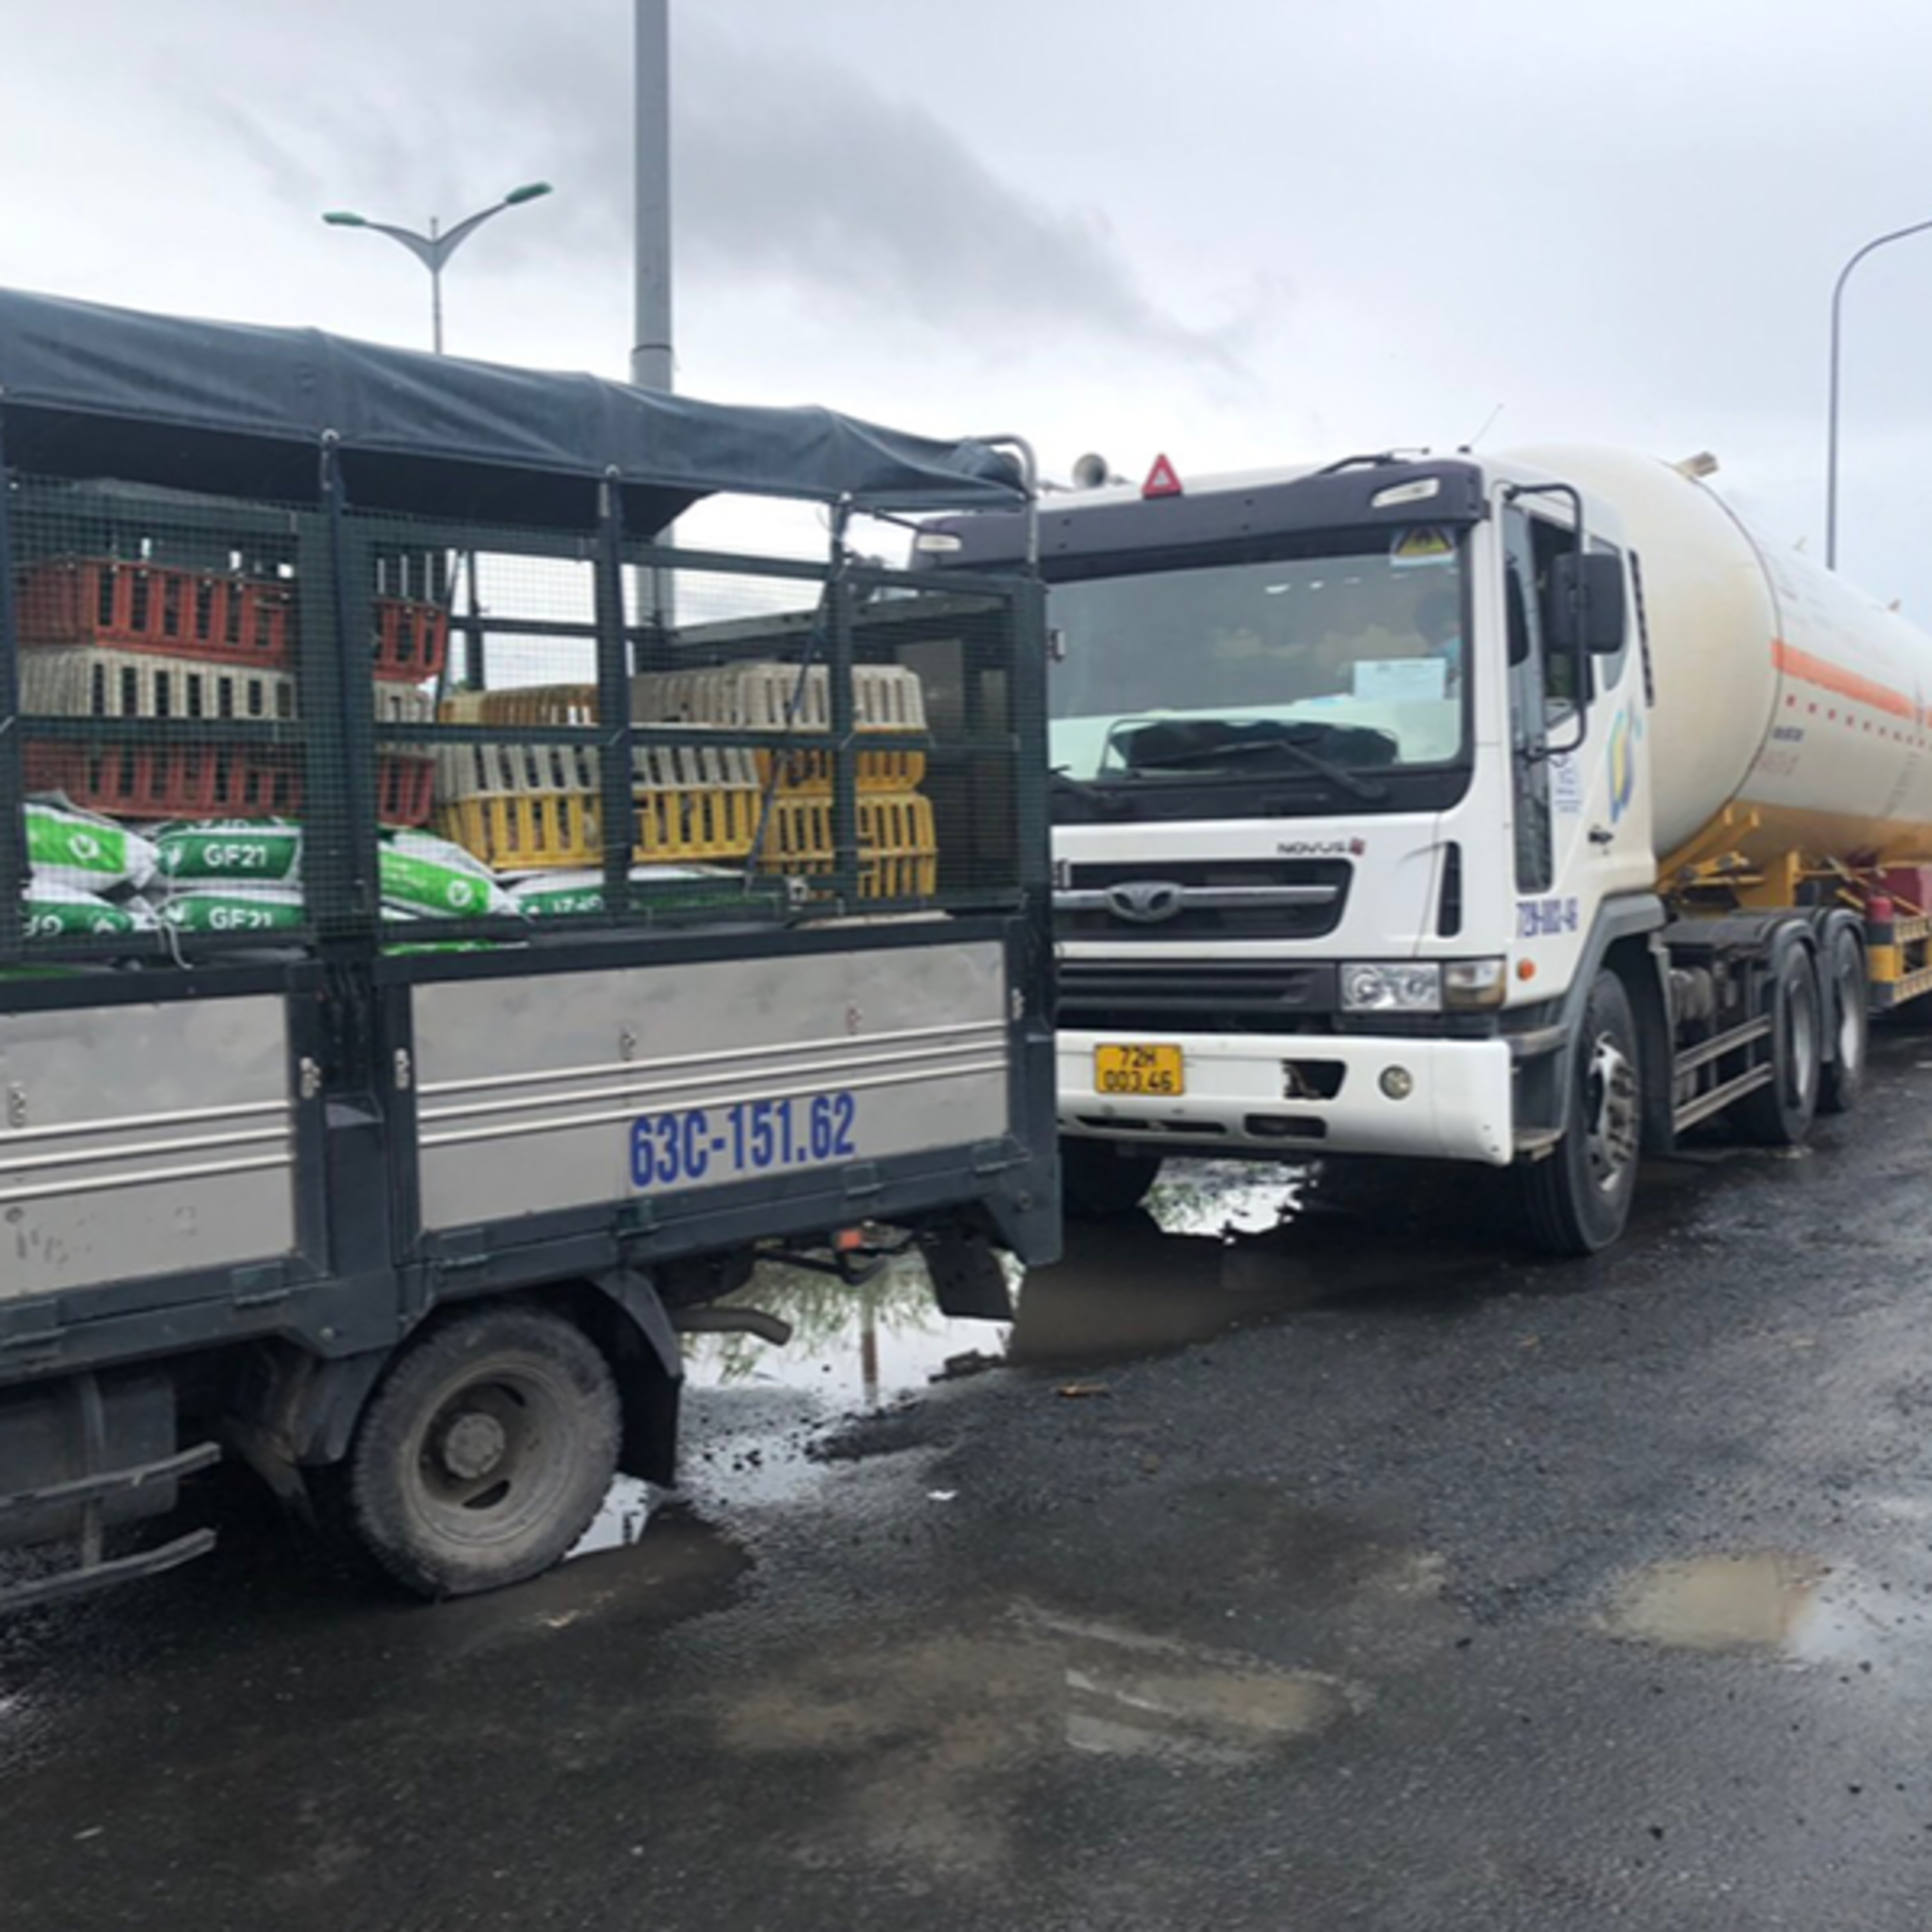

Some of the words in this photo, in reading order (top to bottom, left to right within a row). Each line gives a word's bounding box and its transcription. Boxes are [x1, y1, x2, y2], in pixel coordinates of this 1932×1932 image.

[204, 844, 267, 867] GF21
[1277, 842, 1346, 855] NOVUS
[1119, 1045, 1156, 1068] 72H
[630, 1091, 854, 1188] 63C-151.62
